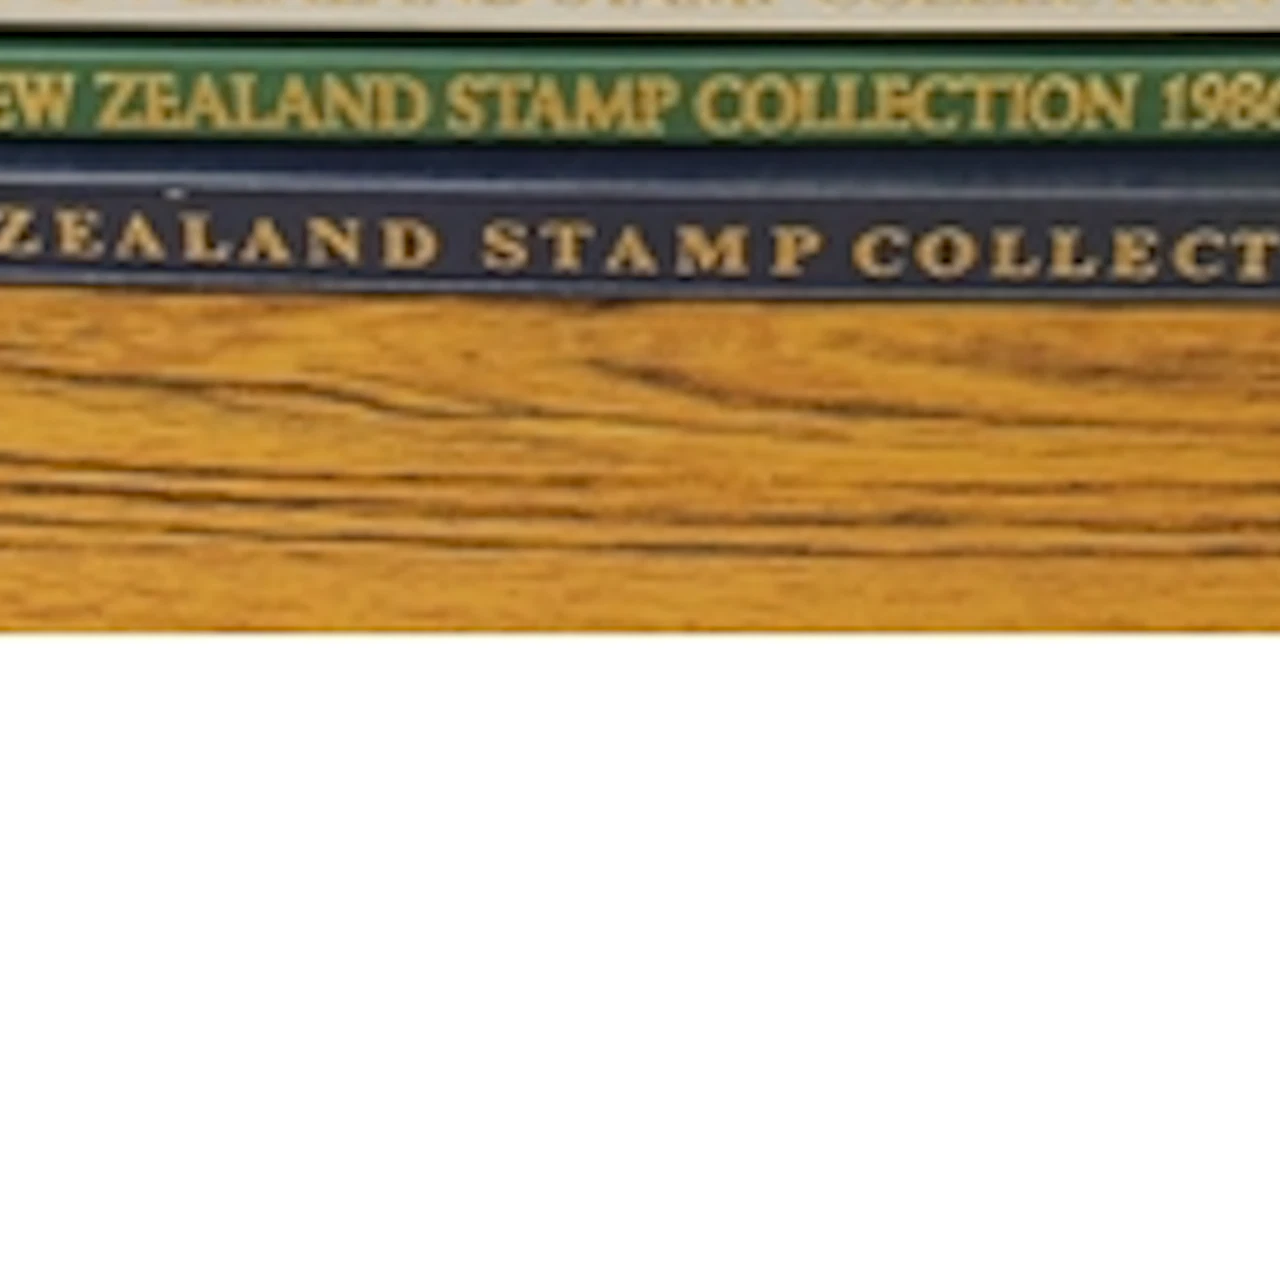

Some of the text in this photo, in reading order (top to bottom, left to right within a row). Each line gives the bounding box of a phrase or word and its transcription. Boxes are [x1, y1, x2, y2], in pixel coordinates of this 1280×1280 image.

[93, 71, 428, 132] ZEALAND
[445, 72, 681, 135] STAMP
[695, 72, 1138, 135] COLLECTION
[481, 219, 825, 278] STAMP
